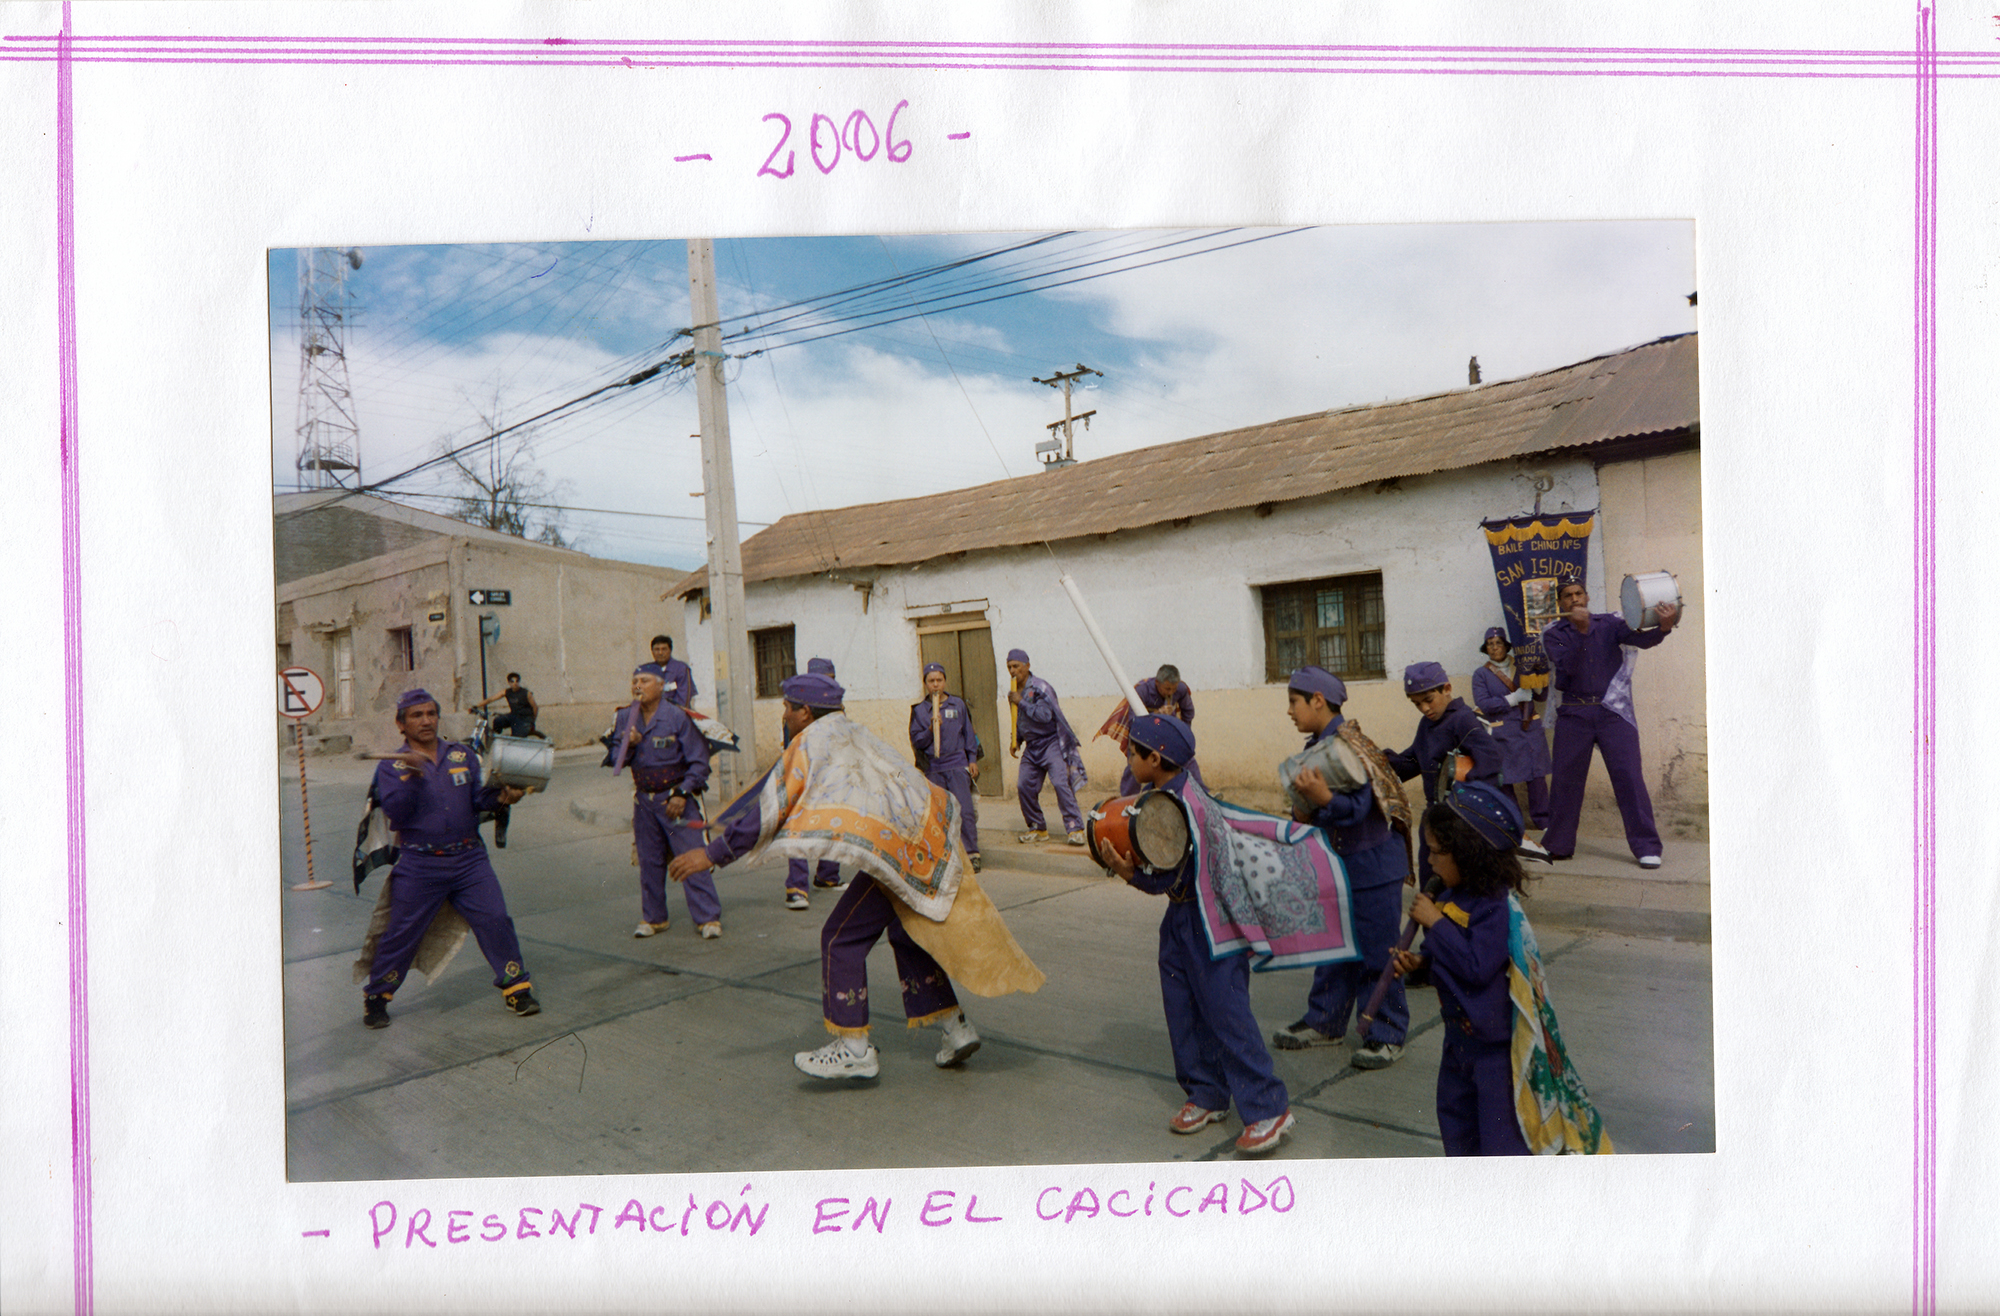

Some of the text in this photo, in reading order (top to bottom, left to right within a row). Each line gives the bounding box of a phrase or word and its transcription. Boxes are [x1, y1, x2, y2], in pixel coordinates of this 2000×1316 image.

[756, 99, 913, 180] 2006
[1498, 542, 1523, 555] BAILE
[1531, 540, 1559, 551] CHINO
[1496, 557, 1582, 586] SAN ISIDRO
[812, 1197, 892, 1235] EN
[919, 1190, 1003, 1228] EL
